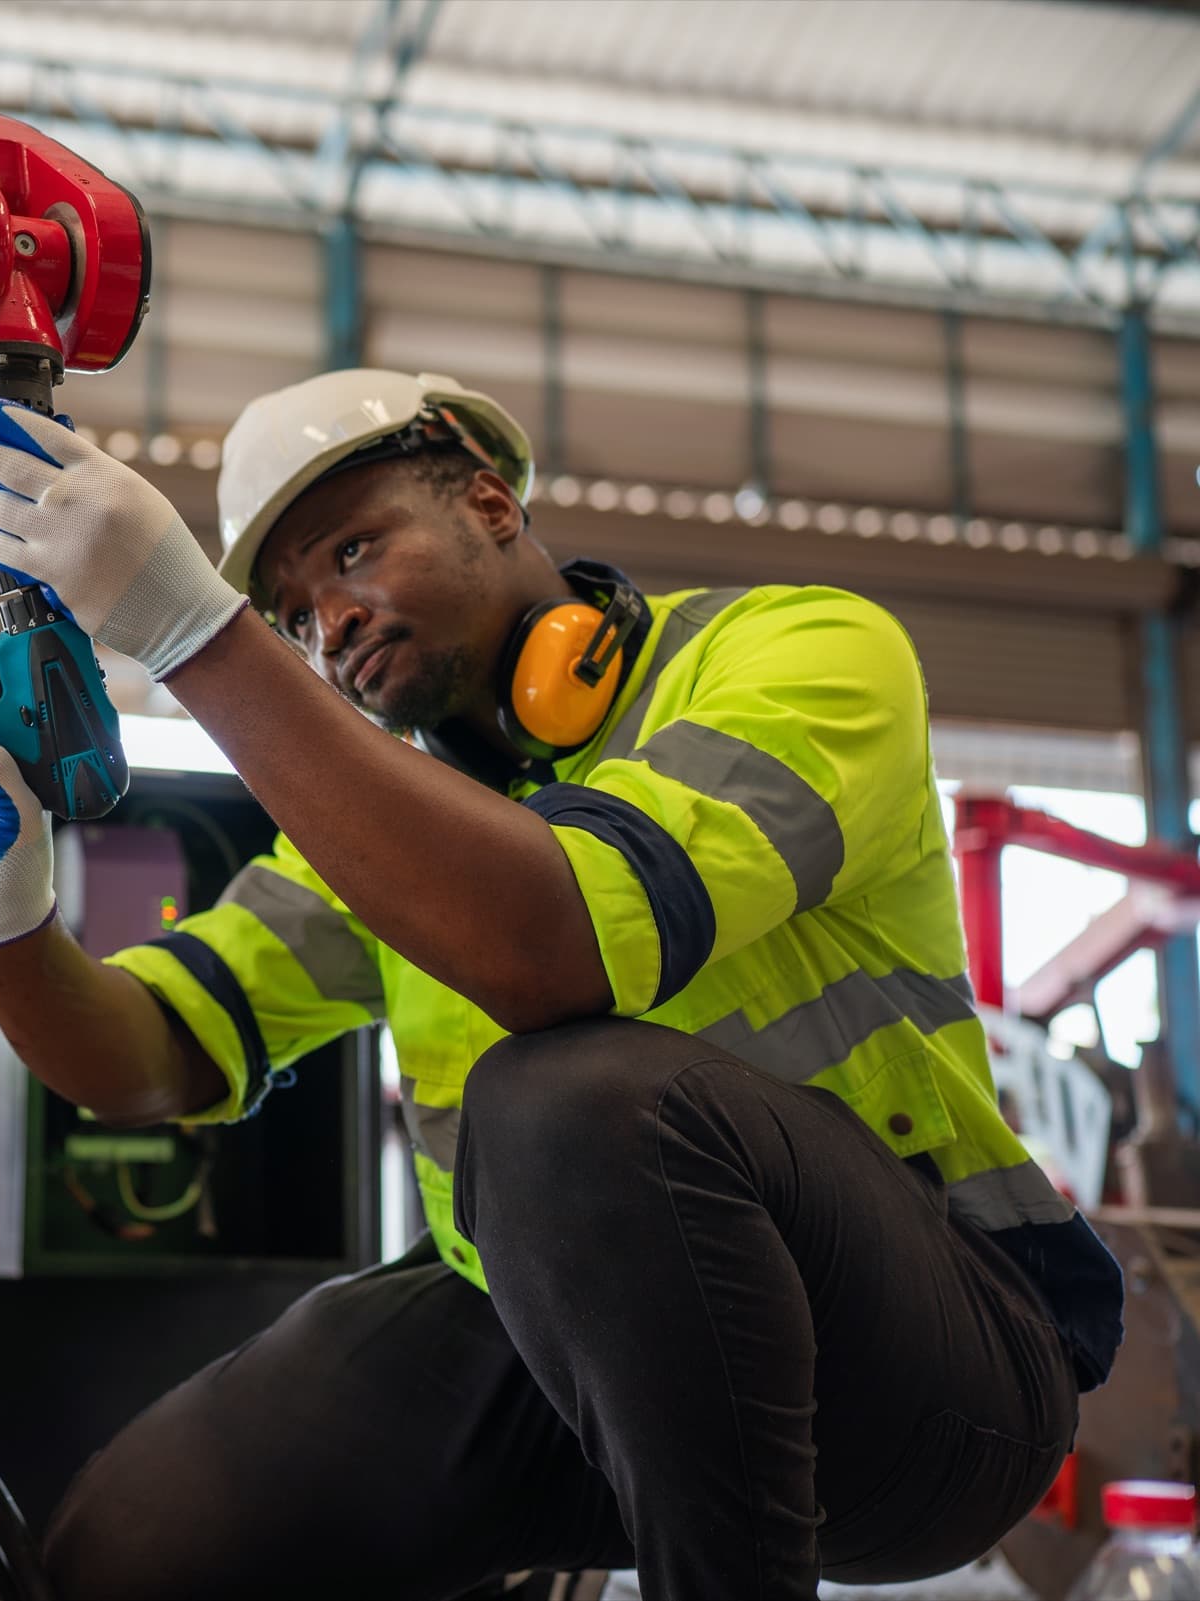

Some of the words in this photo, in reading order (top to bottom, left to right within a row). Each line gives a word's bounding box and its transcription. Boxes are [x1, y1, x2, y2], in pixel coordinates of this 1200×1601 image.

[11, 624, 18, 634] 2
[28, 618, 36, 628] 4
[47, 612, 55, 622] 6
